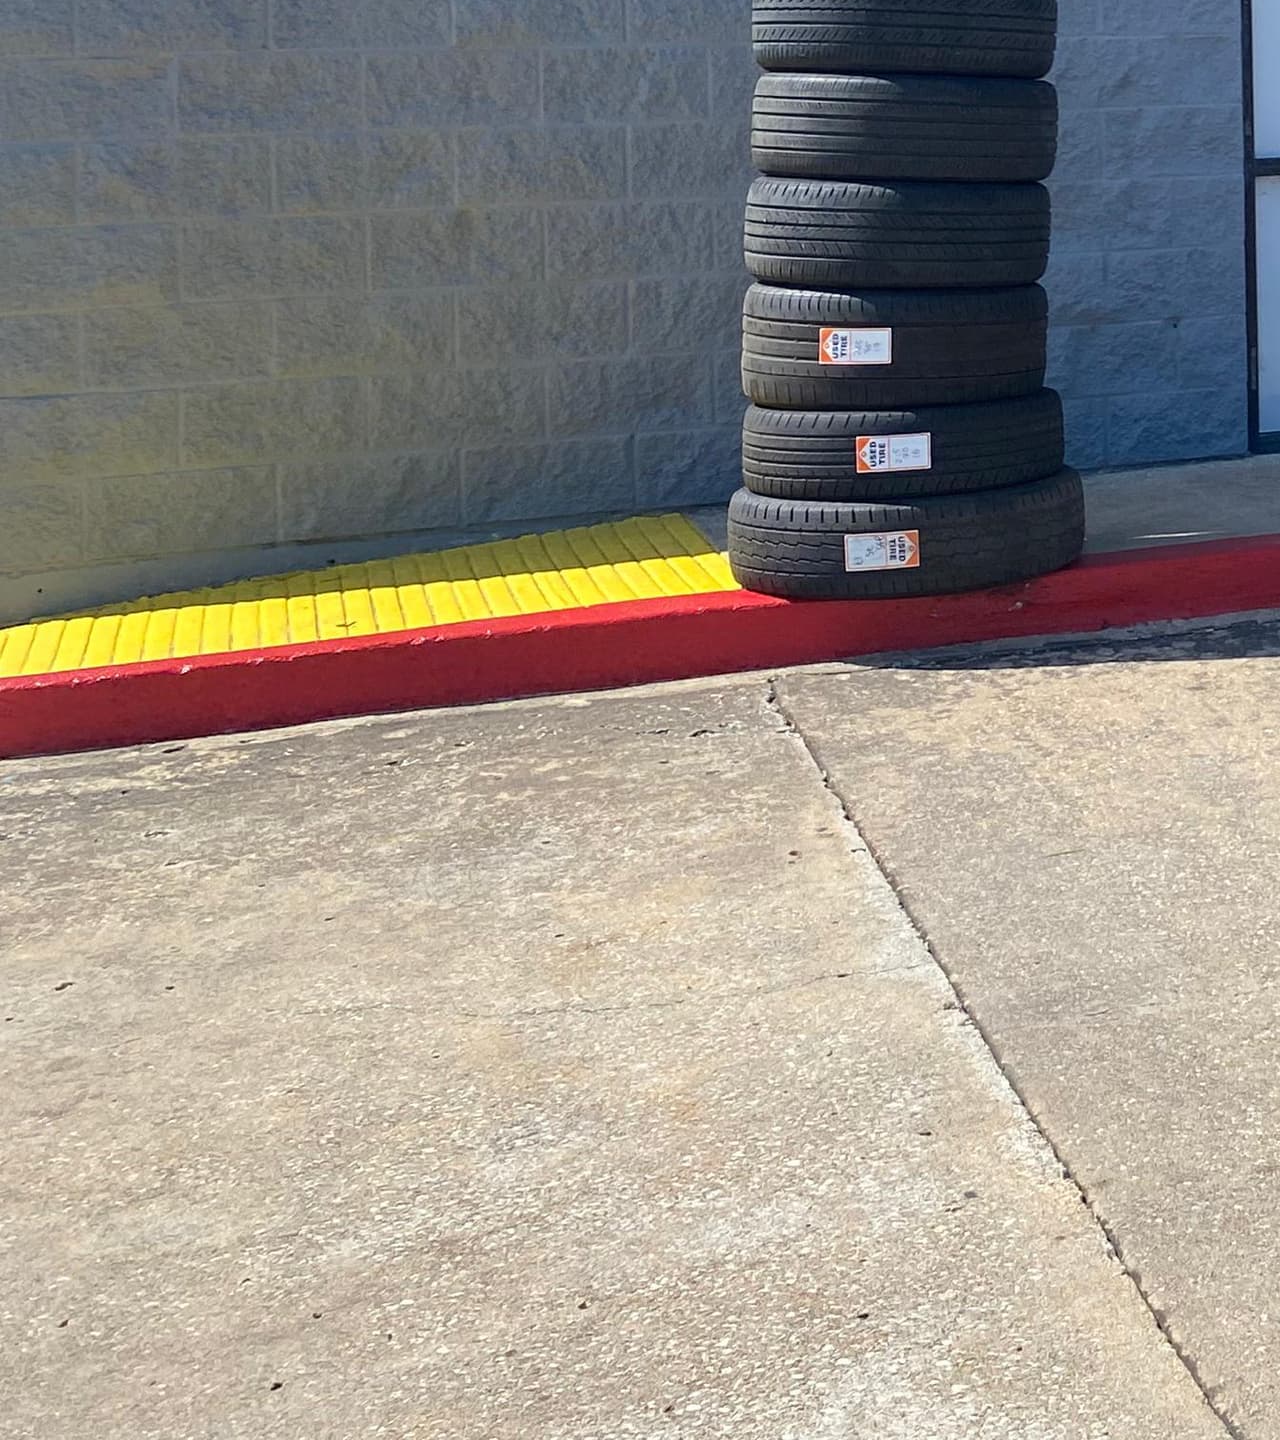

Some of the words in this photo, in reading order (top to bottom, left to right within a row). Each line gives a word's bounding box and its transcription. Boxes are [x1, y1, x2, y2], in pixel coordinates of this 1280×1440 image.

[869, 442, 877, 467] USED
[878, 443, 886, 465] TIRE
[889, 538, 897, 560] TIRE
[898, 536, 906, 561] USED
